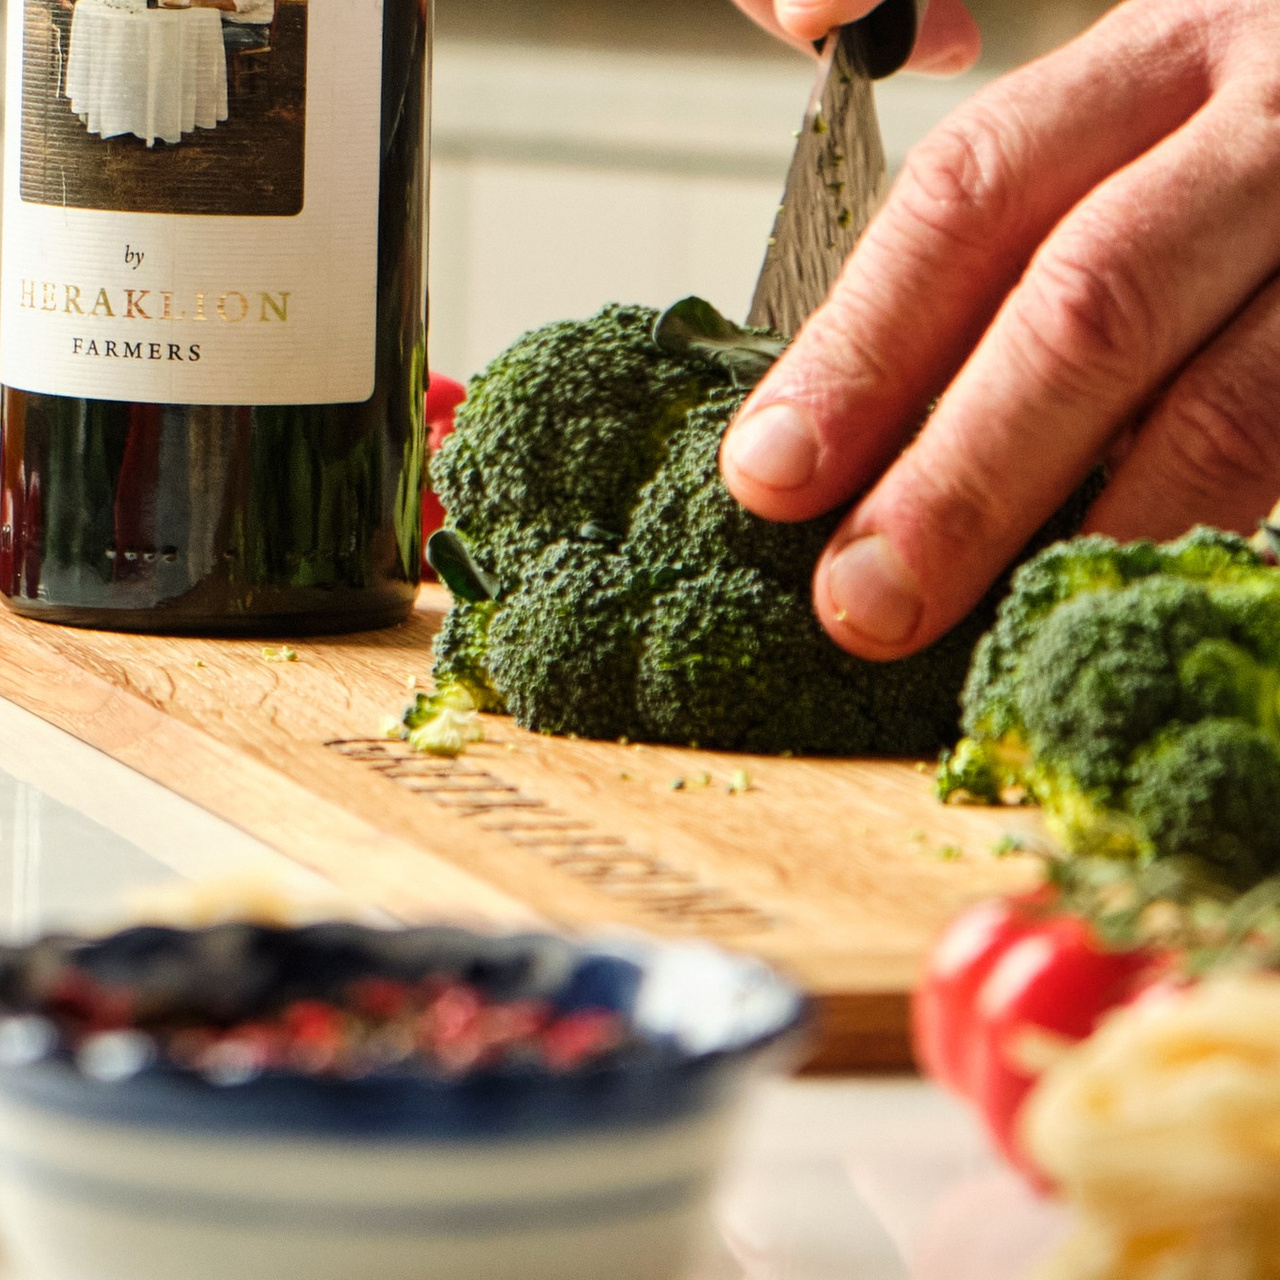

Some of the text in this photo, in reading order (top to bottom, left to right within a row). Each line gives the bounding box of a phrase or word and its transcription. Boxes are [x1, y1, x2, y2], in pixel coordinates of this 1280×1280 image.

[124, 244, 145, 270] by
[20, 278, 291, 323] HERAKLION
[72, 337, 201, 362] FARMERS
